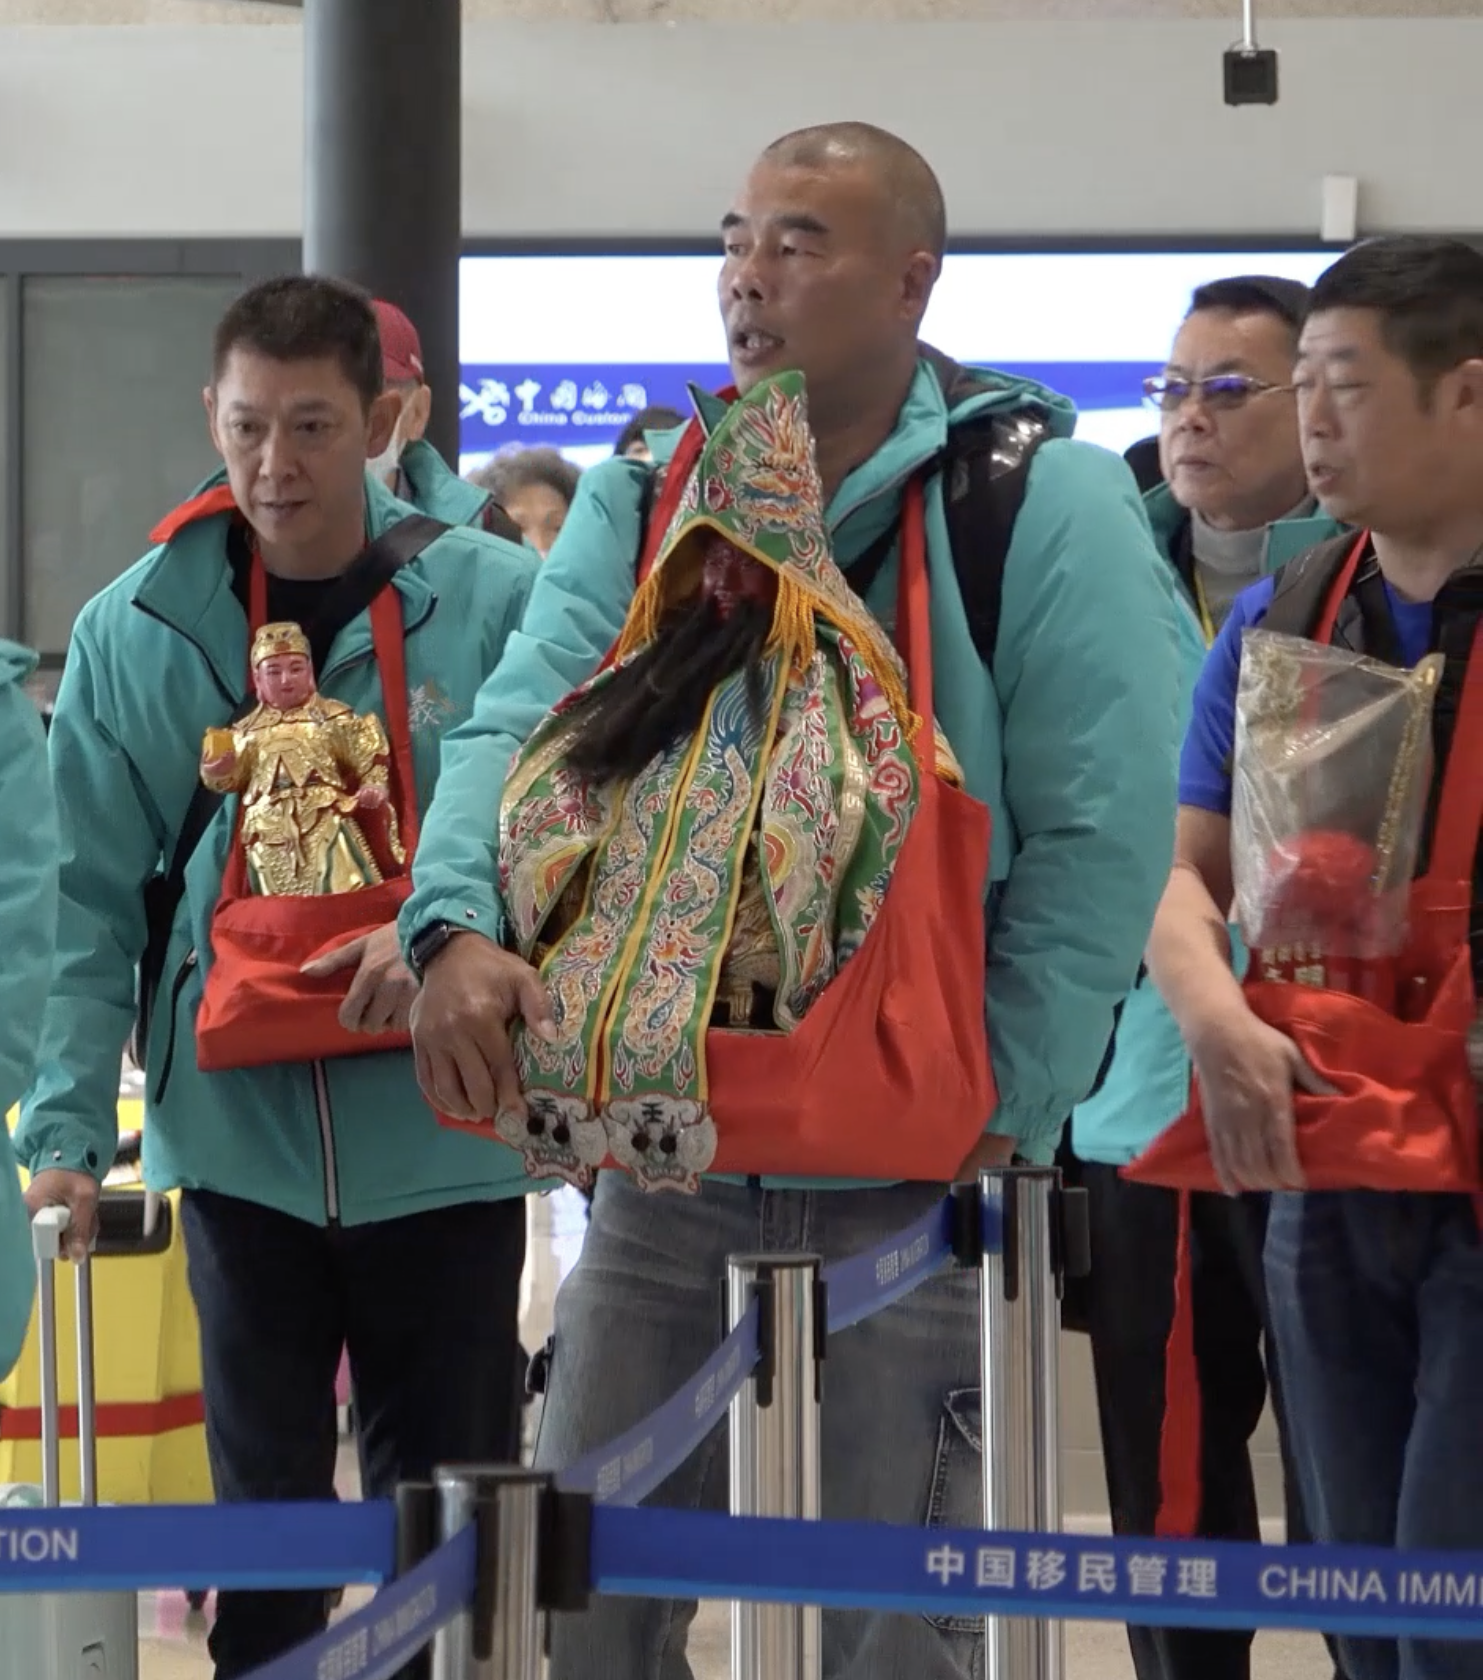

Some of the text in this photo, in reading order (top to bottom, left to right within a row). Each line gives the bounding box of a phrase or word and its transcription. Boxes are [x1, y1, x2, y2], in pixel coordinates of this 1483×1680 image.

[518, 412, 568, 426] China
[926, 1544, 1217, 1598] 中国移民管理
[1260, 1563, 1387, 1603] CHINA
